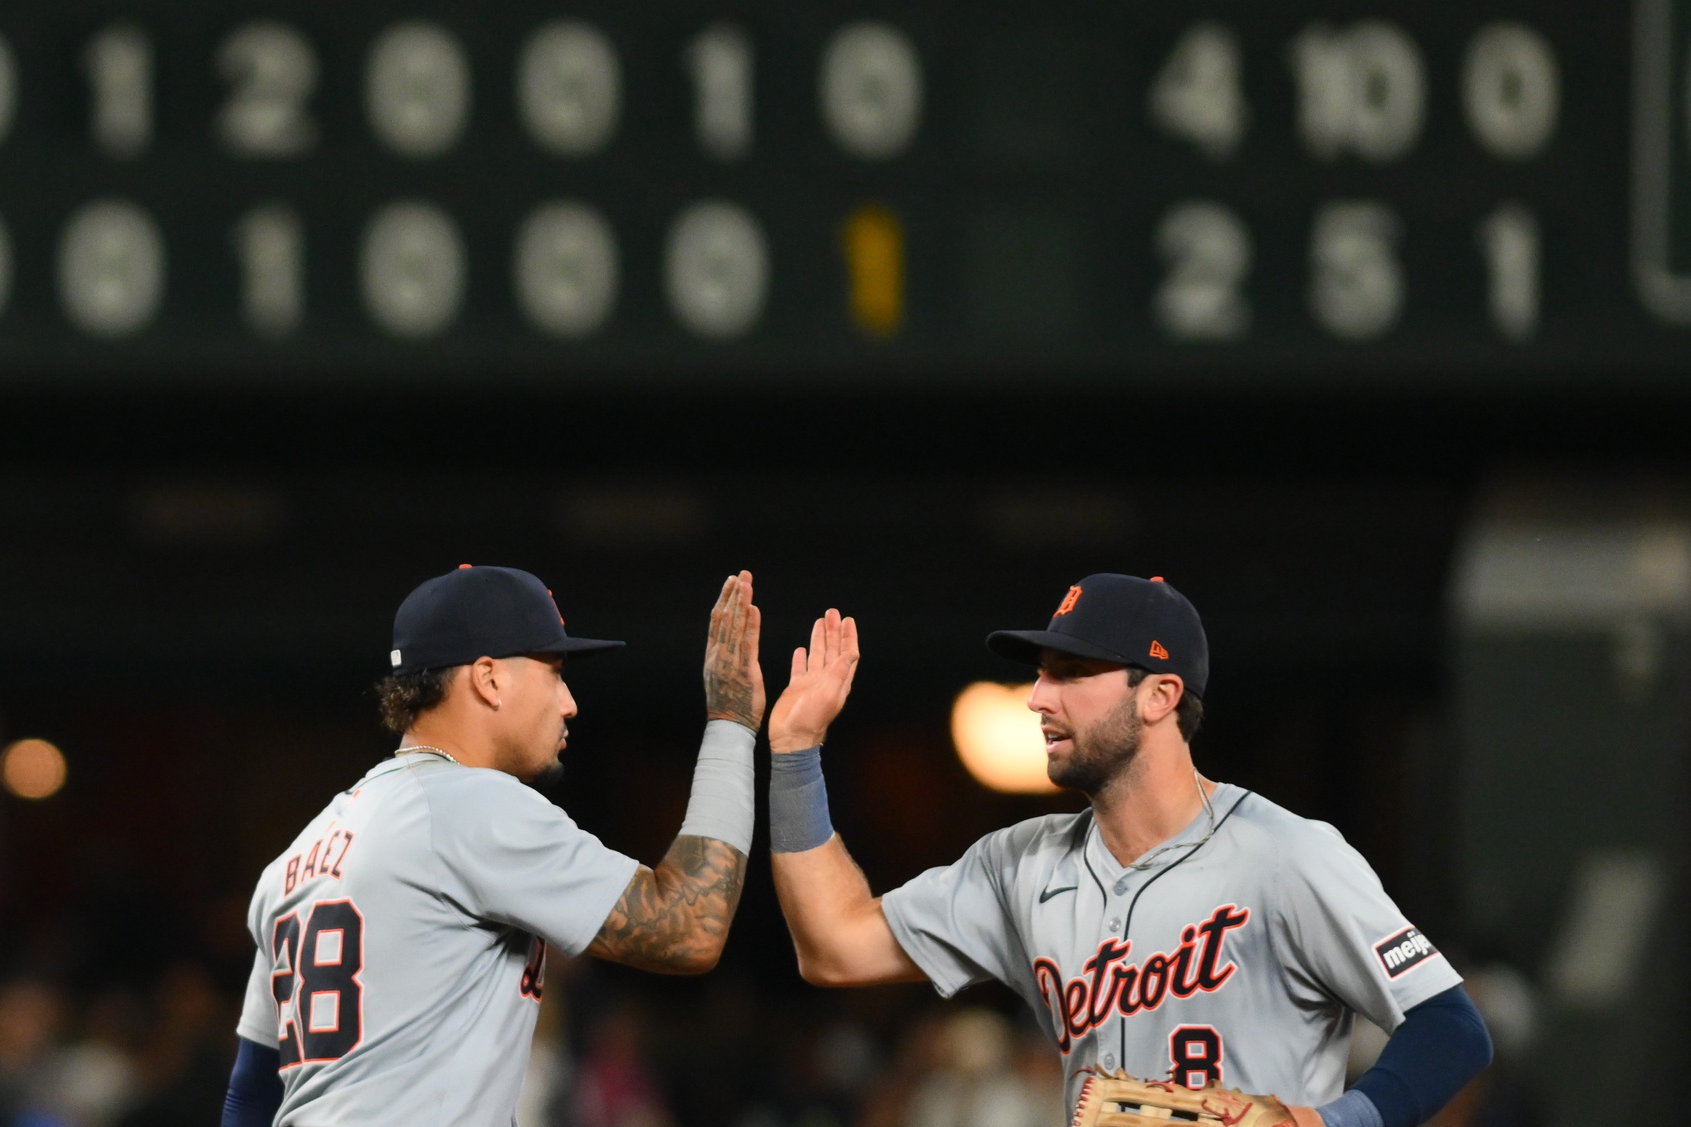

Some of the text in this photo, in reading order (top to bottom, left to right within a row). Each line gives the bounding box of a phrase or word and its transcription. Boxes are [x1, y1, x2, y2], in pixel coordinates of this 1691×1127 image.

[90, 28, 150, 151] 1
[220, 26, 314, 154] 2
[369, 25, 468, 152] 0
[520, 25, 618, 152] 0
[689, 28, 752, 152] 1
[823, 25, 920, 153] 0
[1152, 28, 1246, 154] 4
[1293, 24, 1423, 155] 10
[1465, 26, 1557, 154] 0
[61, 203, 162, 332] 0
[240, 208, 301, 334] 1
[363, 203, 463, 332] 0
[517, 204, 616, 332] 0
[667, 203, 767, 332] 0
[847, 210, 902, 332] 1
[1157, 204, 1249, 334] 2
[1484, 210, 1538, 336] 1
[271, 897, 365, 1075] 28
[1033, 902, 1250, 1055] Detroit
[1382, 930, 1432, 970] meije
[1167, 1023, 1224, 1092] 8
